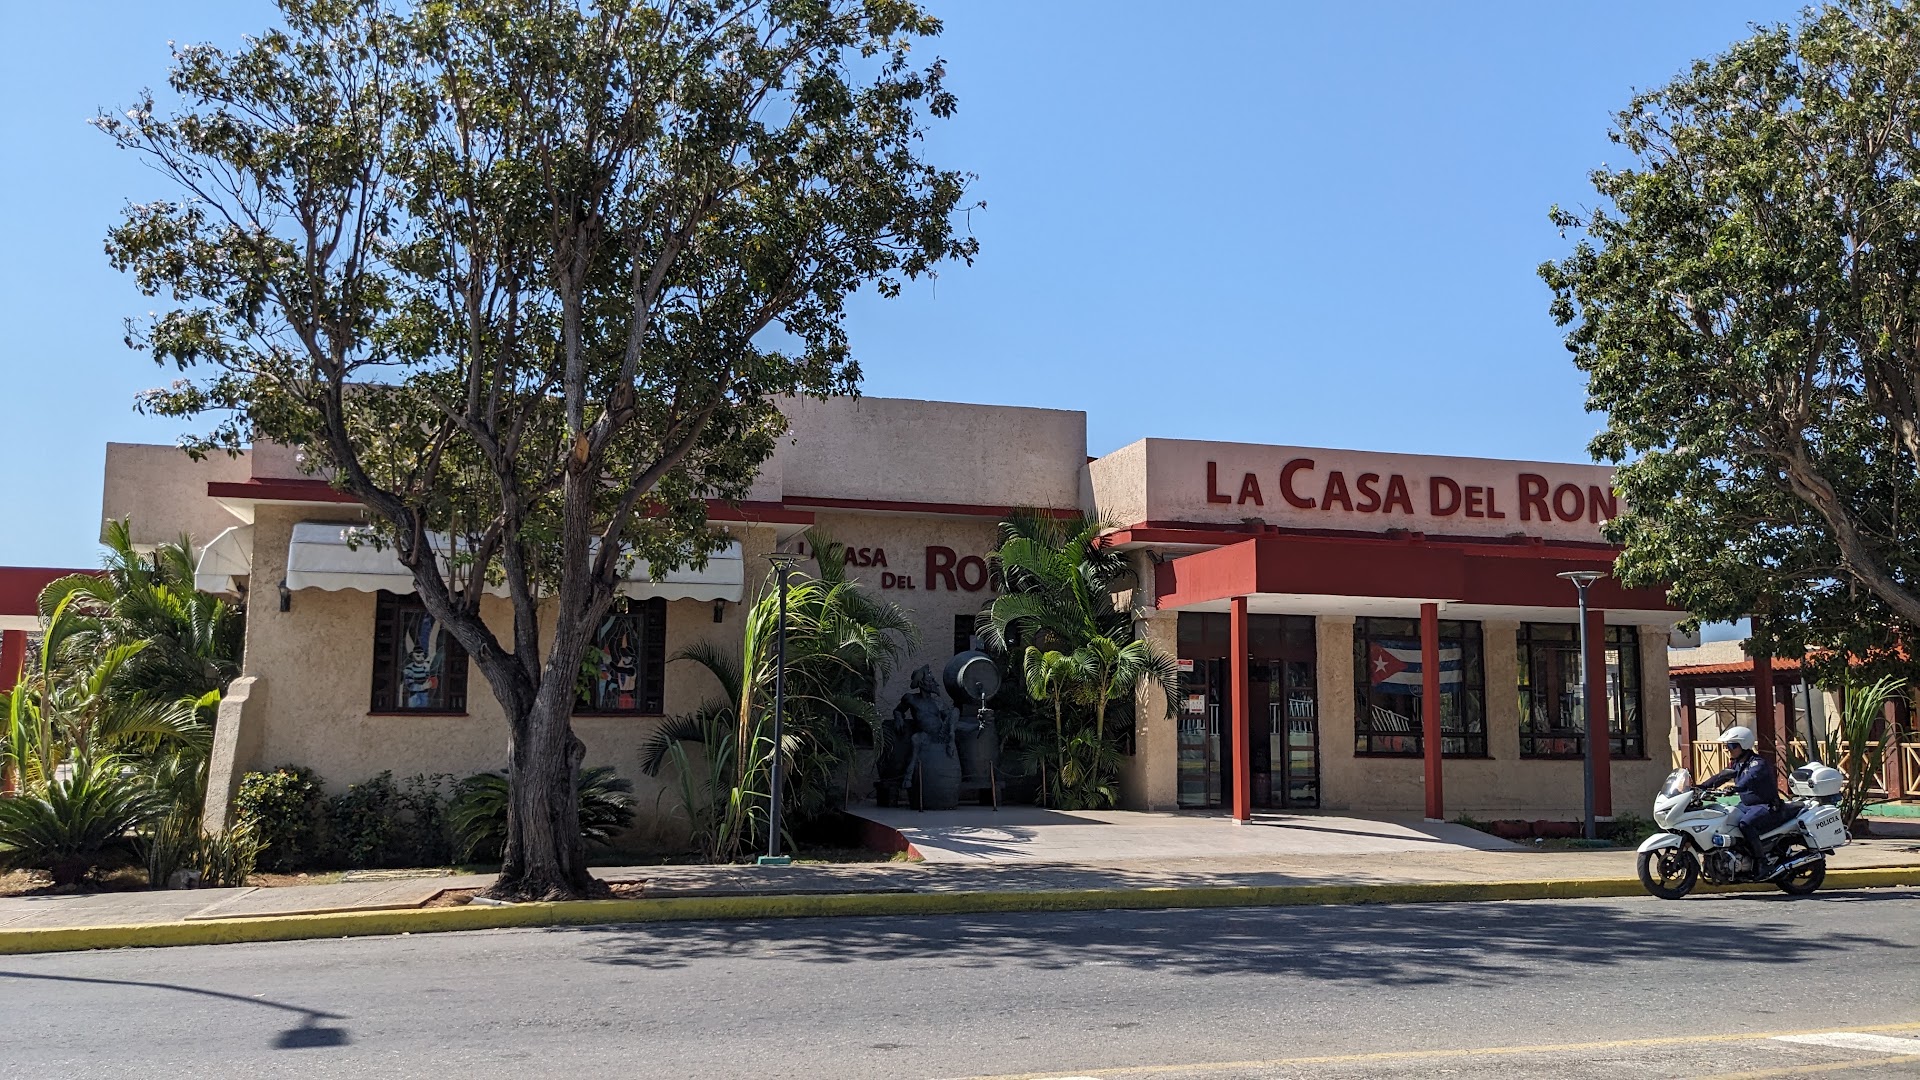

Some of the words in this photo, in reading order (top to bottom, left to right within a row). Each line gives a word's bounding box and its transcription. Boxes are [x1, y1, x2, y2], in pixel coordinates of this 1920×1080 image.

[1207, 461, 1264, 506] LA
[1280, 458, 1415, 515] CASA
[1429, 476, 1506, 519] DEL
[1518, 473, 1618, 524] RON
[881, 571, 916, 590] DEL
[925, 545, 998, 593] RO
[1815, 815, 1840, 830] POLICIA
